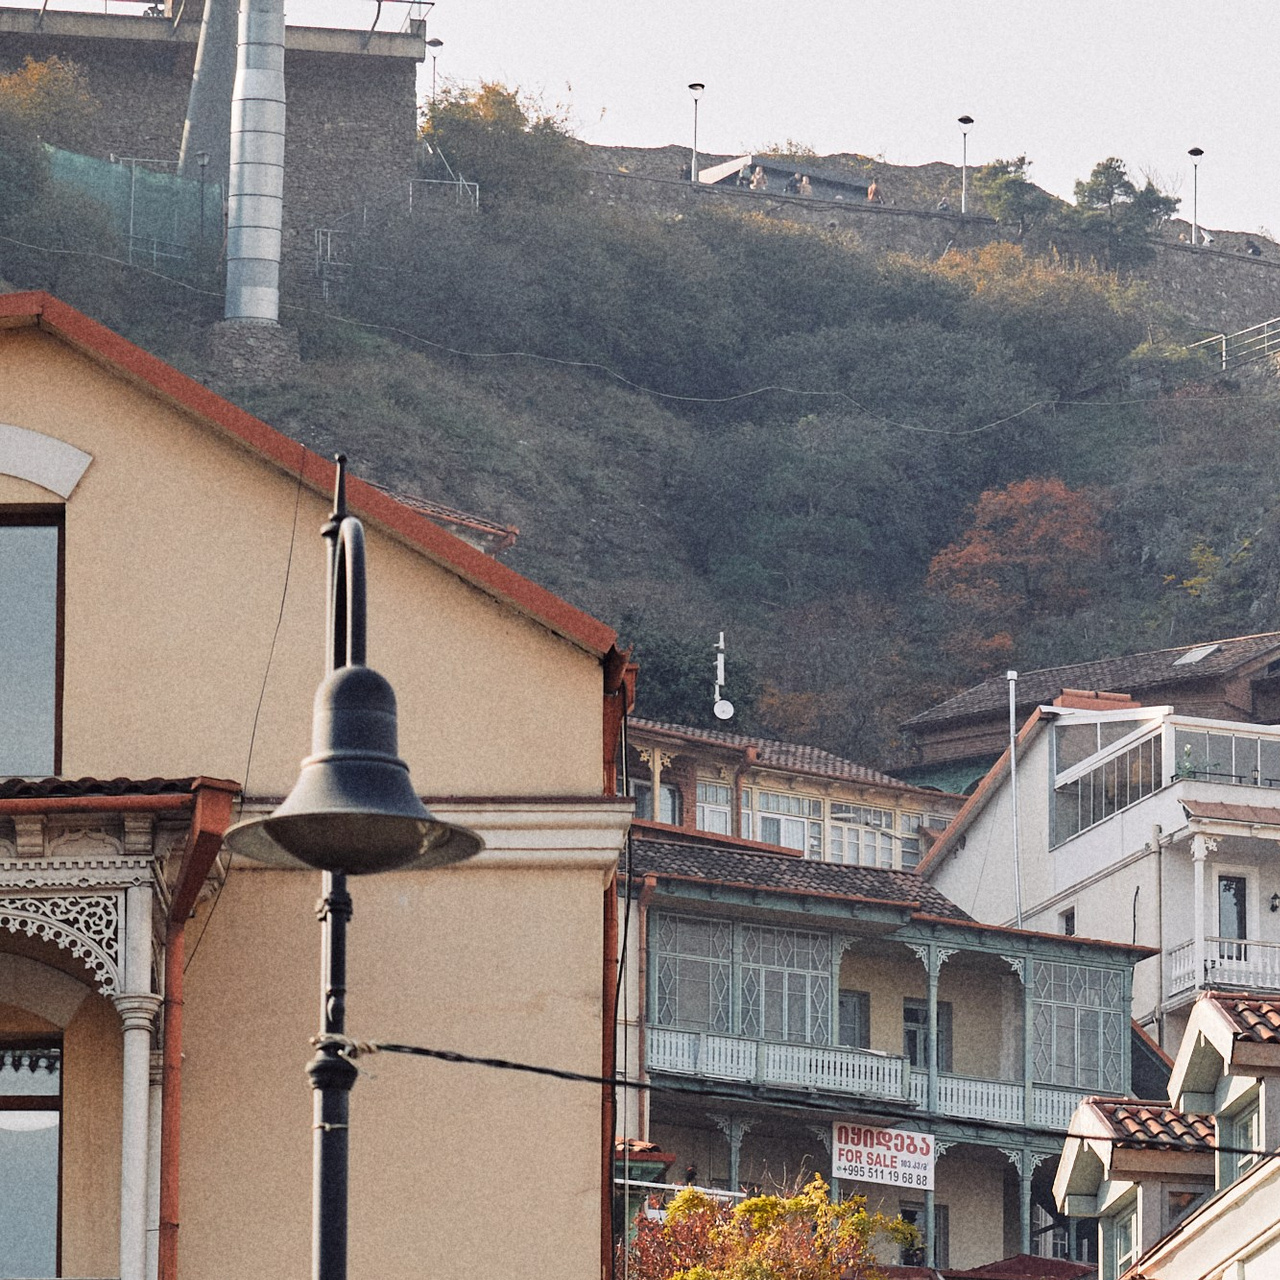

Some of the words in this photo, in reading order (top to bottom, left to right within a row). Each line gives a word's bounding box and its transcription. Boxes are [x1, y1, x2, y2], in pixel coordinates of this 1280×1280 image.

[837, 1125, 931, 1157] იყიდება
[838, 1148, 862, 1164] FOR
[866, 1152, 898, 1169] SALE
[842, 1164, 866, 1177] +995
[868, 1167, 885, 1180] 511
[888, 1171, 899, 1182] 19
[901, 1172, 914, 1184] 68
[916, 1175, 928, 1187] 88
